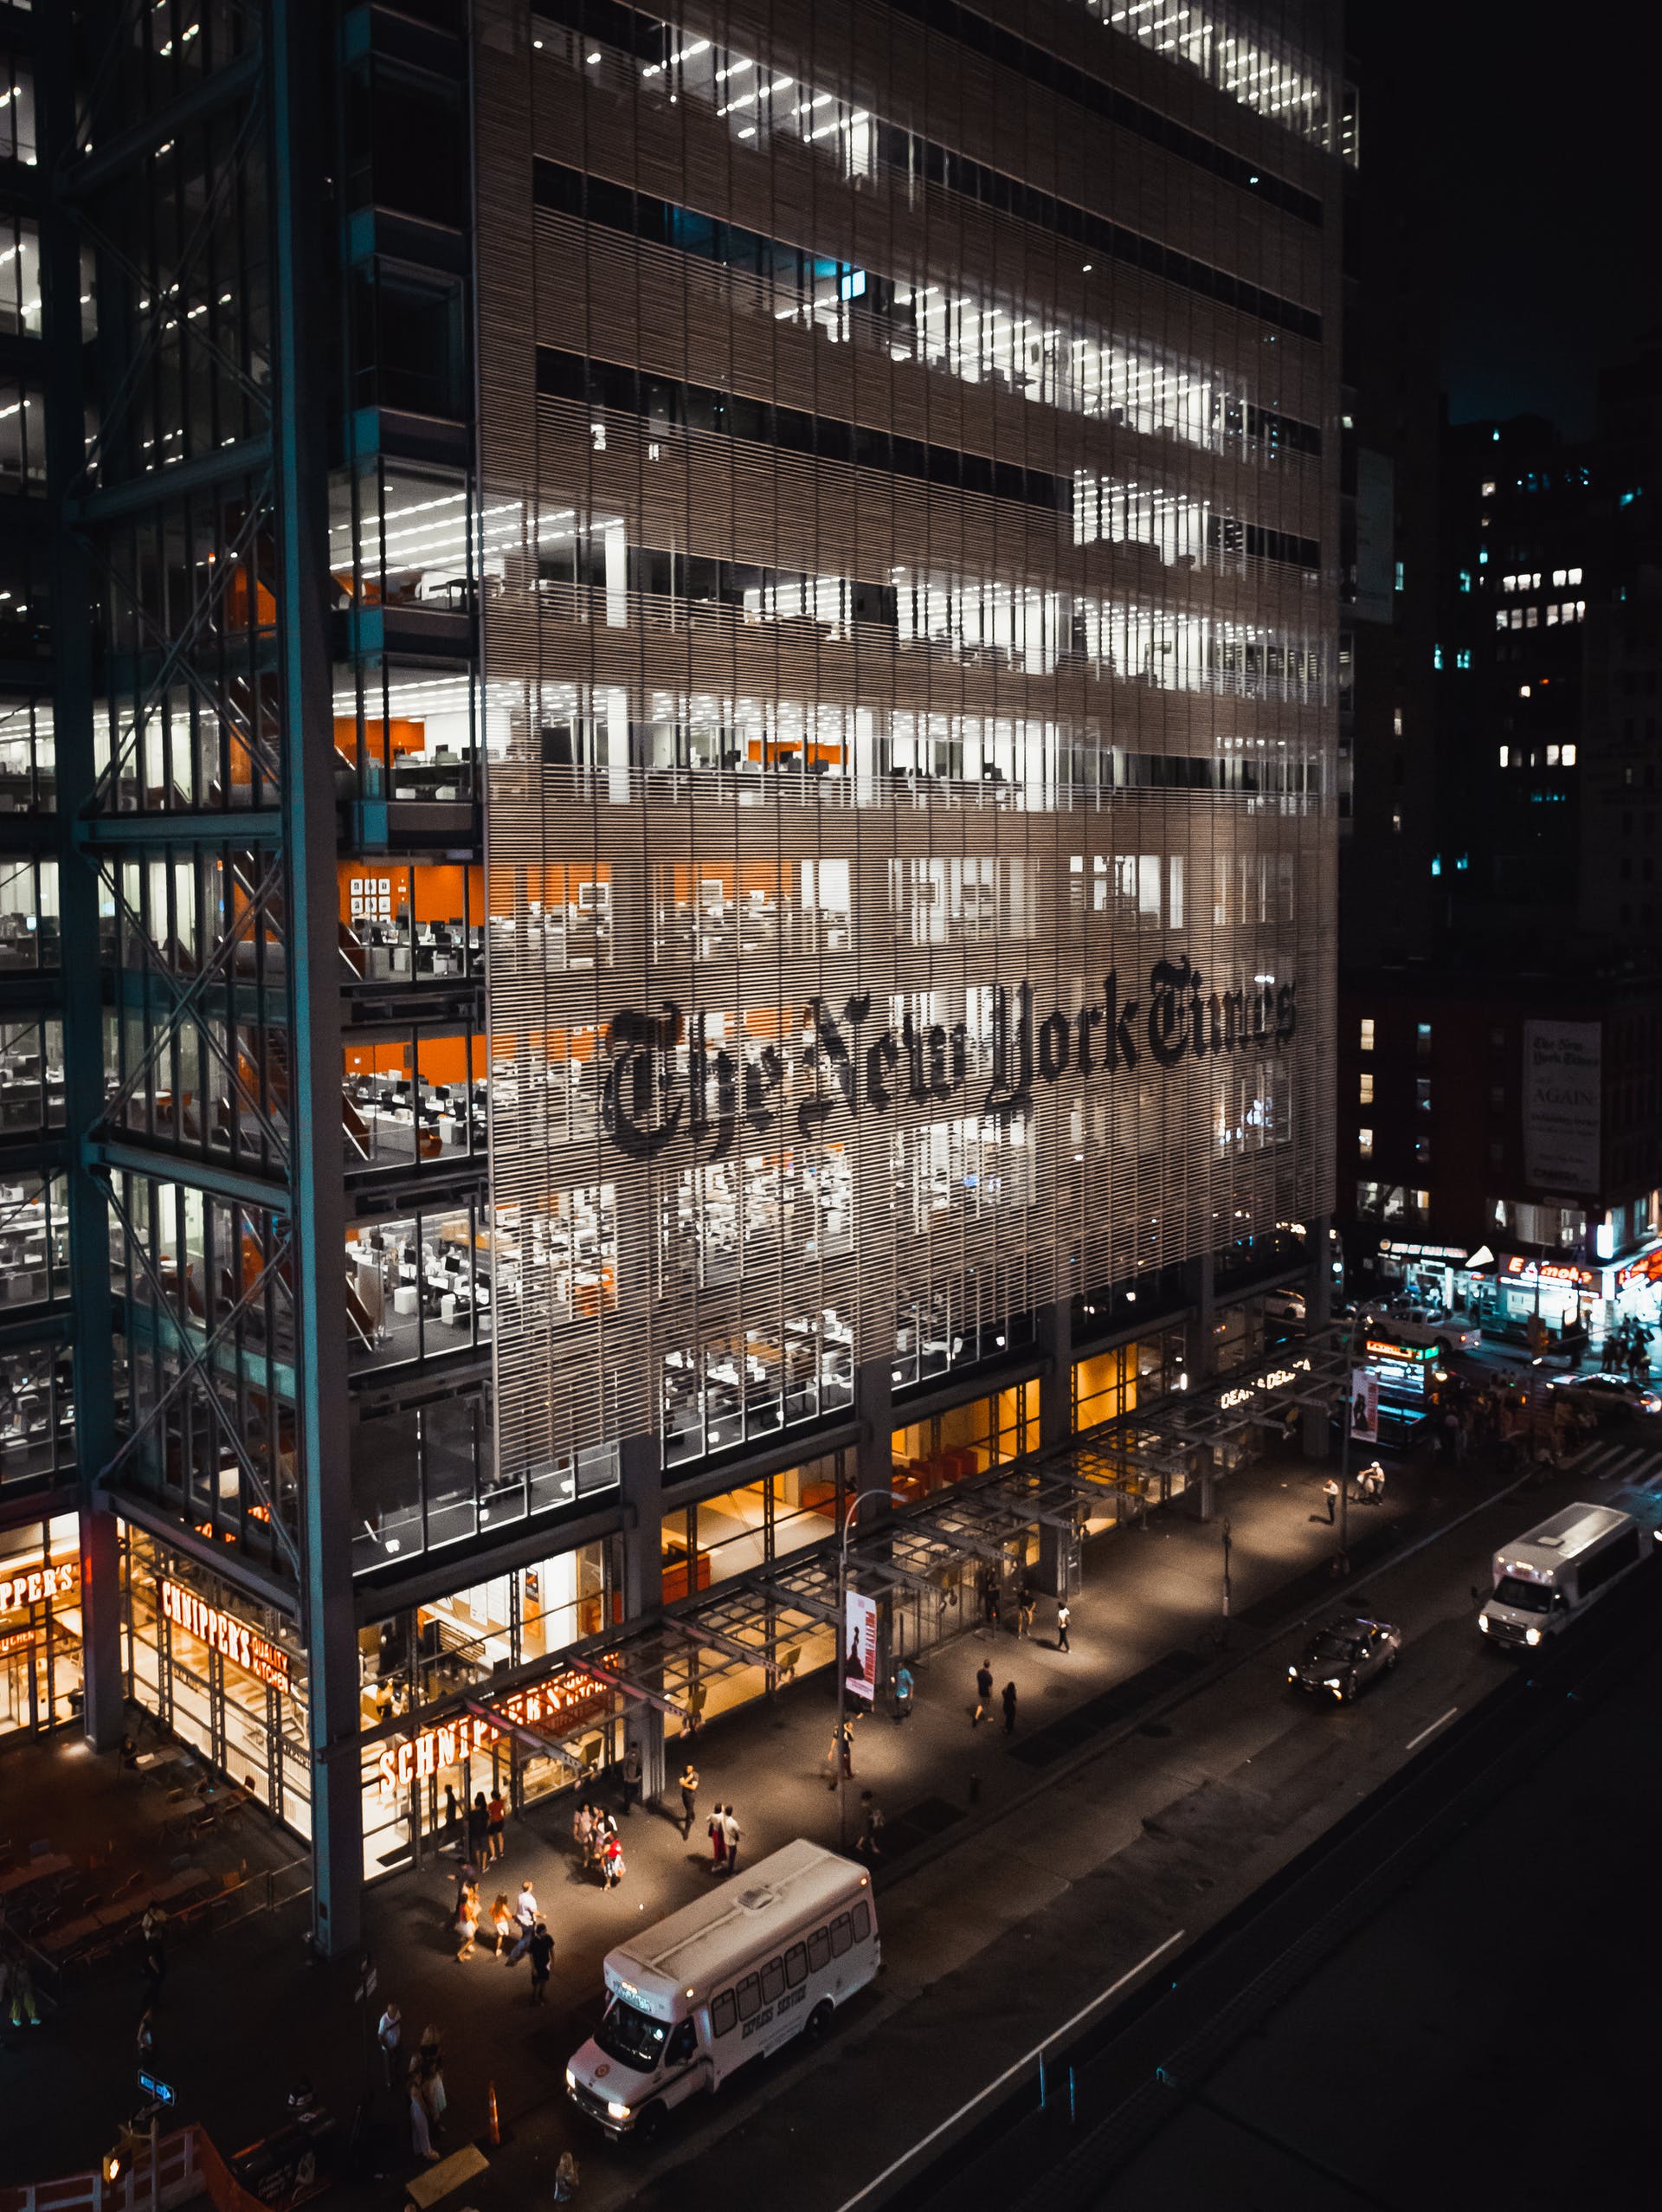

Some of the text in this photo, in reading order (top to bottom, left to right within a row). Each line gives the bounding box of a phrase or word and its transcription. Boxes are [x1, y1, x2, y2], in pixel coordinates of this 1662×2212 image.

[797, 993, 970, 1139] New
[984, 971, 1138, 1125] York
[252, 1635, 288, 1673] QUALITY
[253, 1657, 290, 1694] KITCHEN
